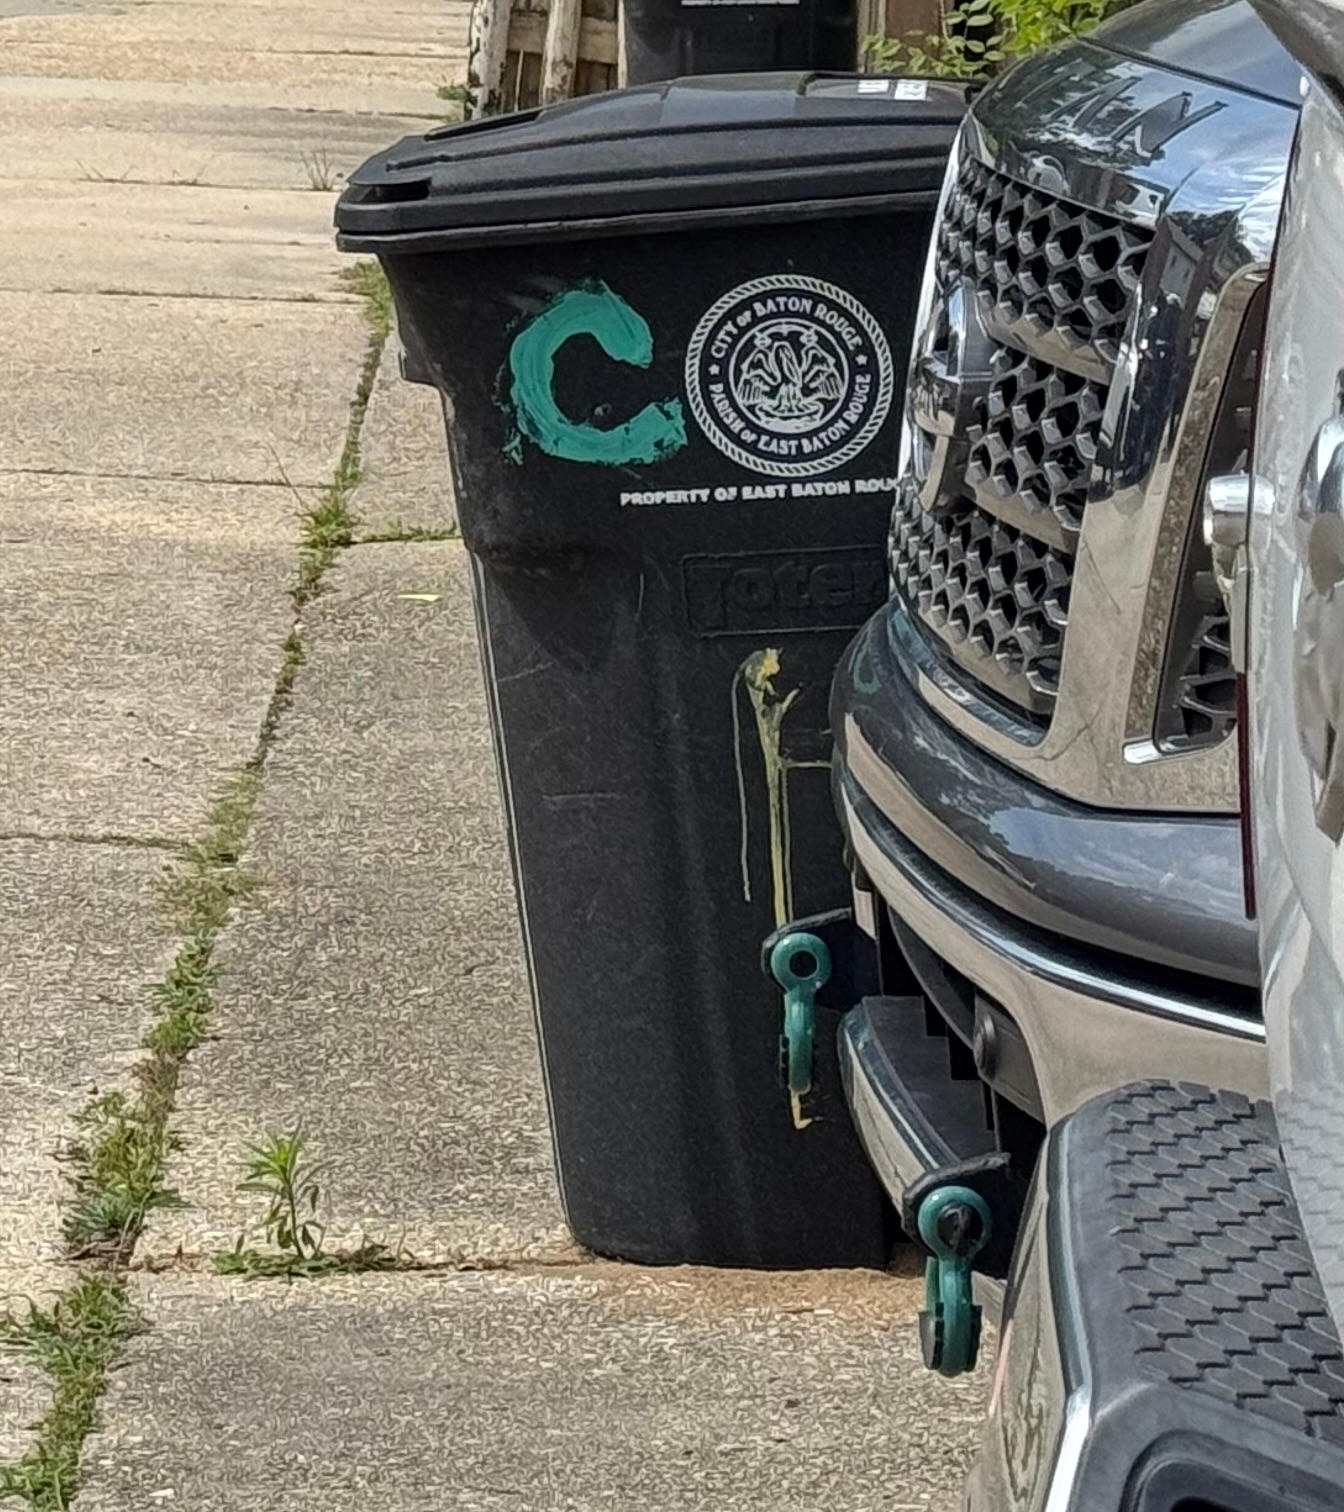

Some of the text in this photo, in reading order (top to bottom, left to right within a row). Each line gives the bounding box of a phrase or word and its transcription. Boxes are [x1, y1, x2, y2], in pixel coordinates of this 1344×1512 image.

[711, 320, 739, 358] CITY
[752, 296, 813, 317] BATON
[814, 303, 863, 351] ROUGE
[508, 284, 688, 465] C
[709, 383, 746, 434] PARISH
[757, 435, 799, 455] EAST
[801, 418, 851, 454] BATON
[842, 374, 871, 424] ROUGE
[620, 488, 710, 507] PROPERTY
[715, 486, 739, 502] OF
[742, 482, 788, 500] EAST
[791, 479, 851, 497] BATON
